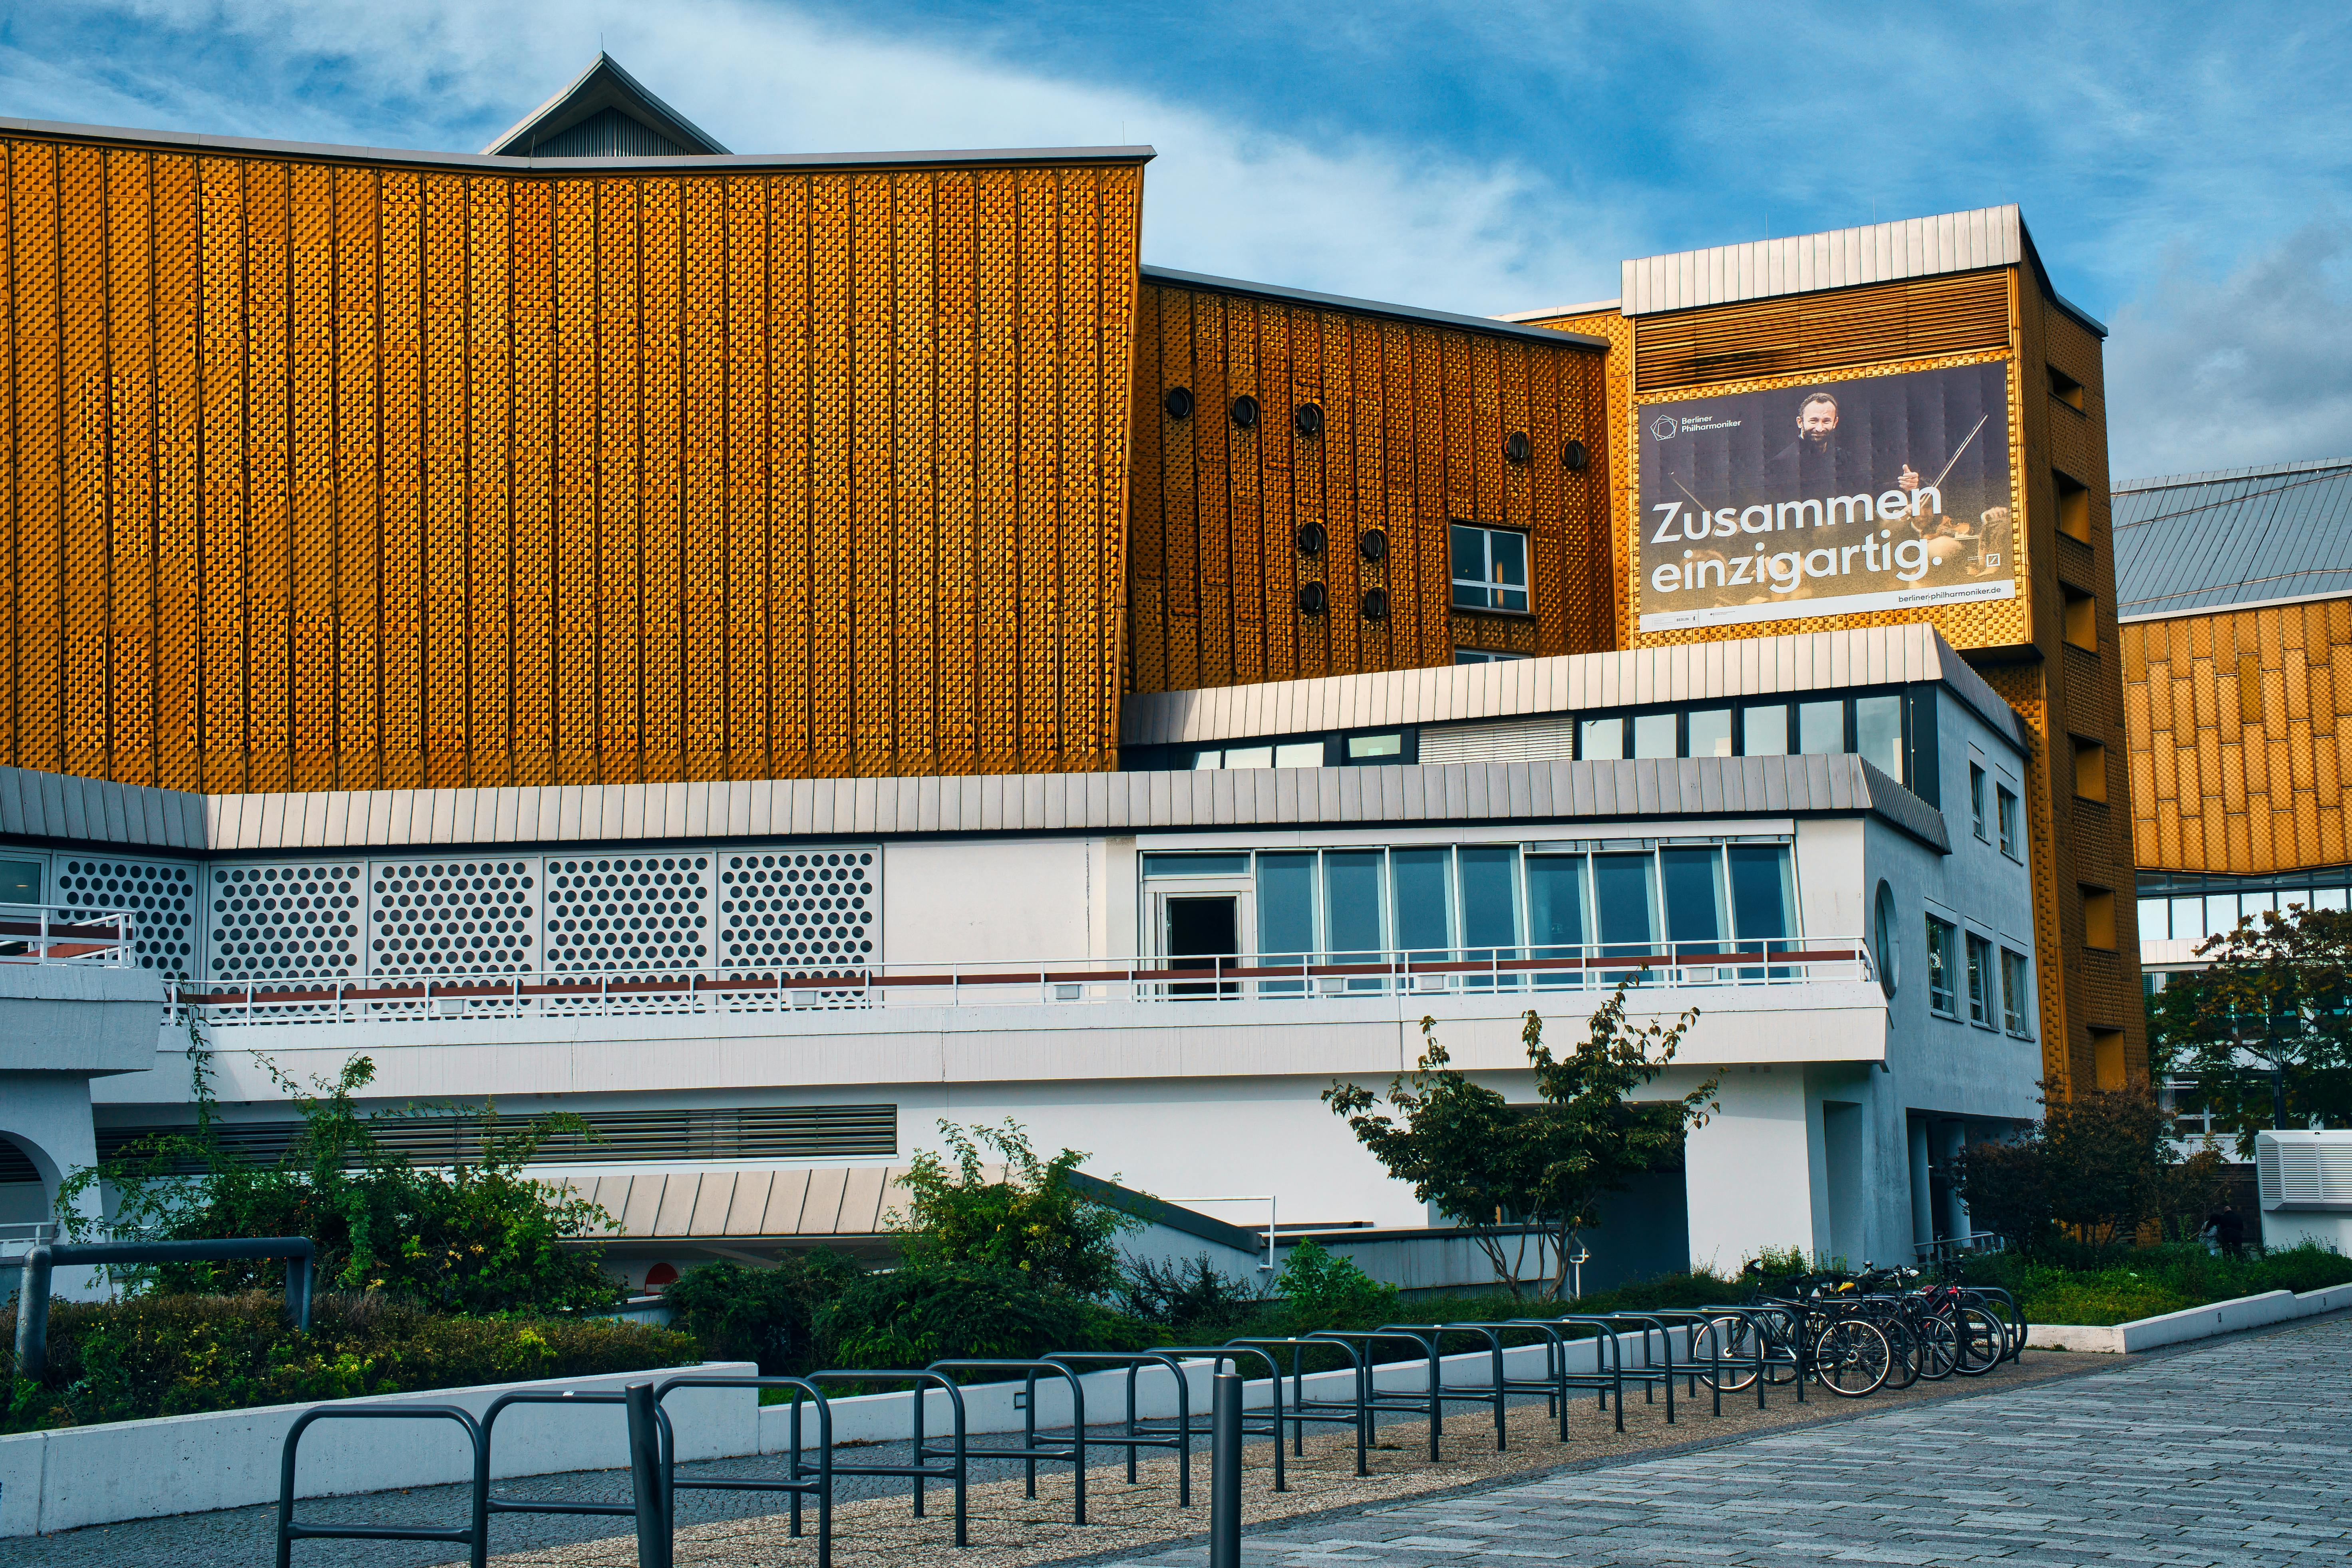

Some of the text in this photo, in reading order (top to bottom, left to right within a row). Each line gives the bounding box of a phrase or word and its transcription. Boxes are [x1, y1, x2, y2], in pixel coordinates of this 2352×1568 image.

[1682, 415, 1713, 425] Berliner
[1682, 420, 1742, 433] Philharmoniker
[1650, 486, 1942, 544] Zusammen
[1651, 529, 1942, 594] einzigartig.
[1898, 586, 2001, 602] berliner-philharmoniker.de
